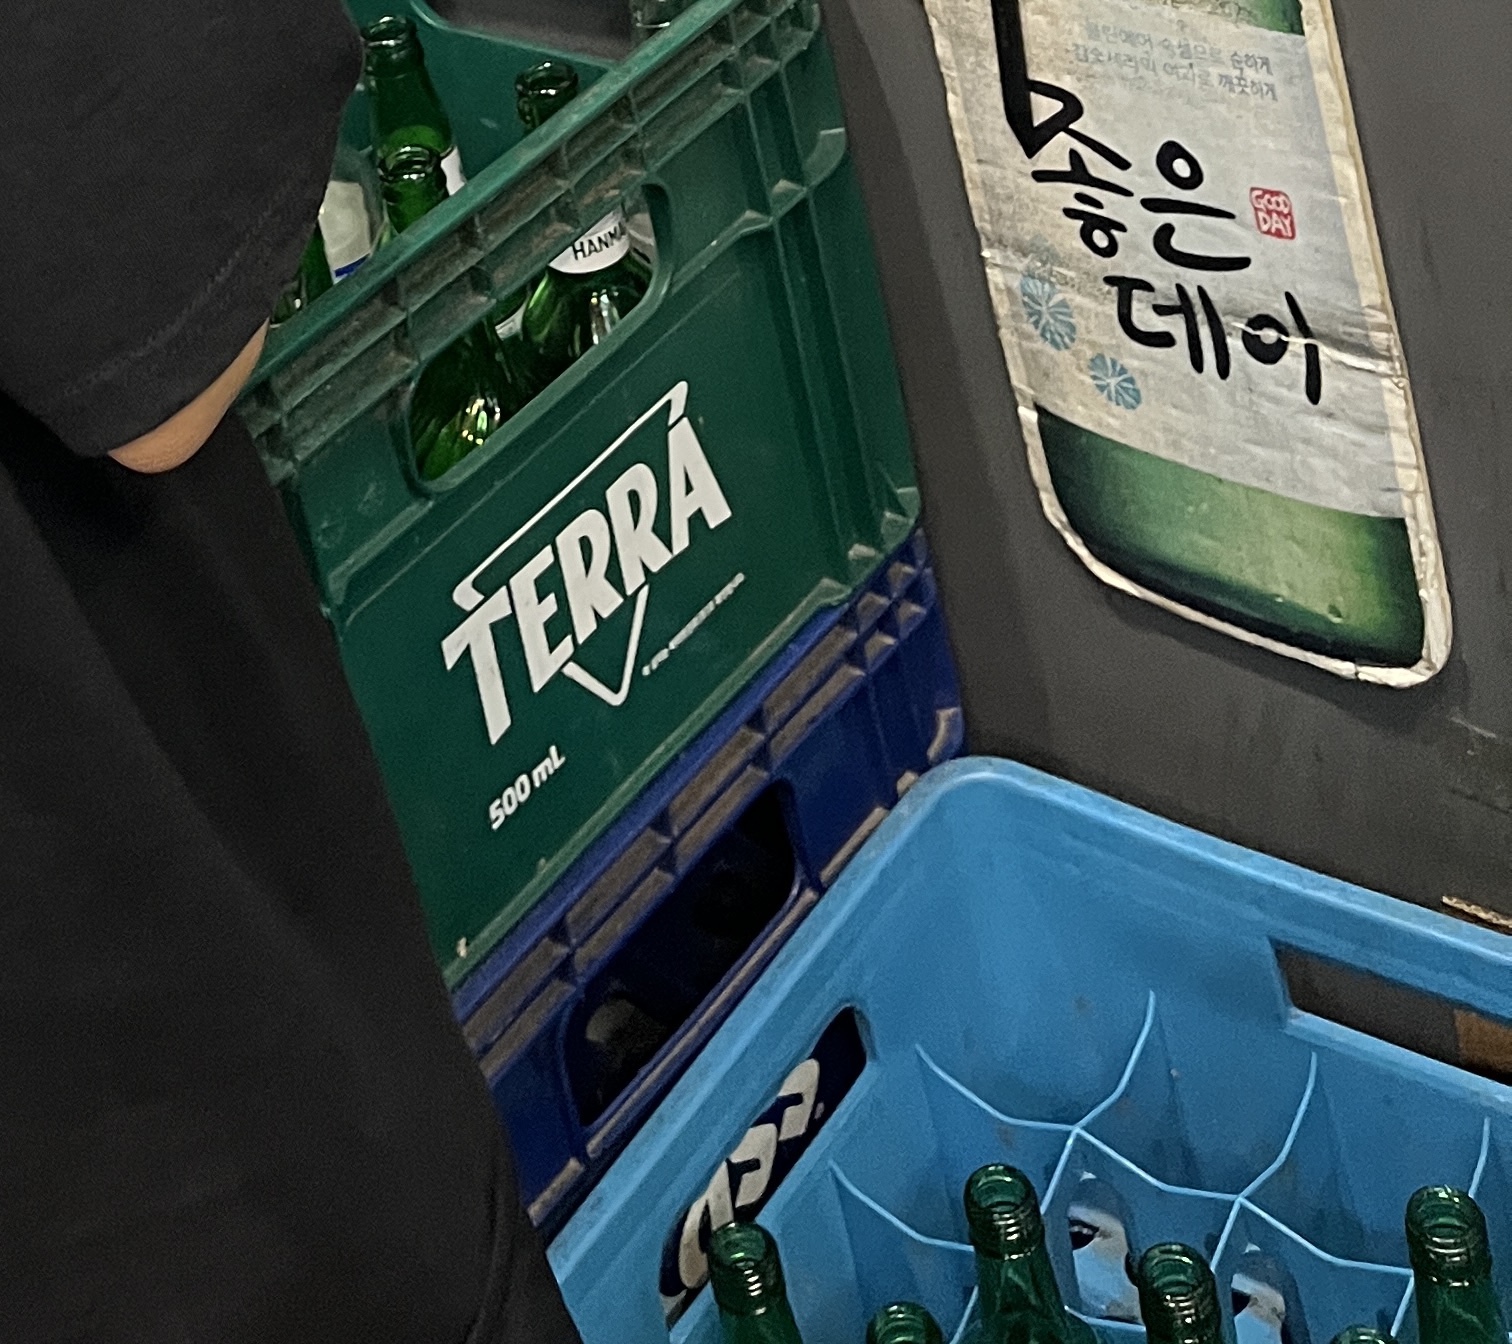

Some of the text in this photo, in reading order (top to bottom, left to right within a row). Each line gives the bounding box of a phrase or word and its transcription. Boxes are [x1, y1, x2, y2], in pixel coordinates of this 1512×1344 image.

[1251, 189, 1292, 215] GOOD
[1256, 211, 1294, 238] DAY
[441, 415, 733, 746] TERRA
[488, 772, 532, 831] 500
